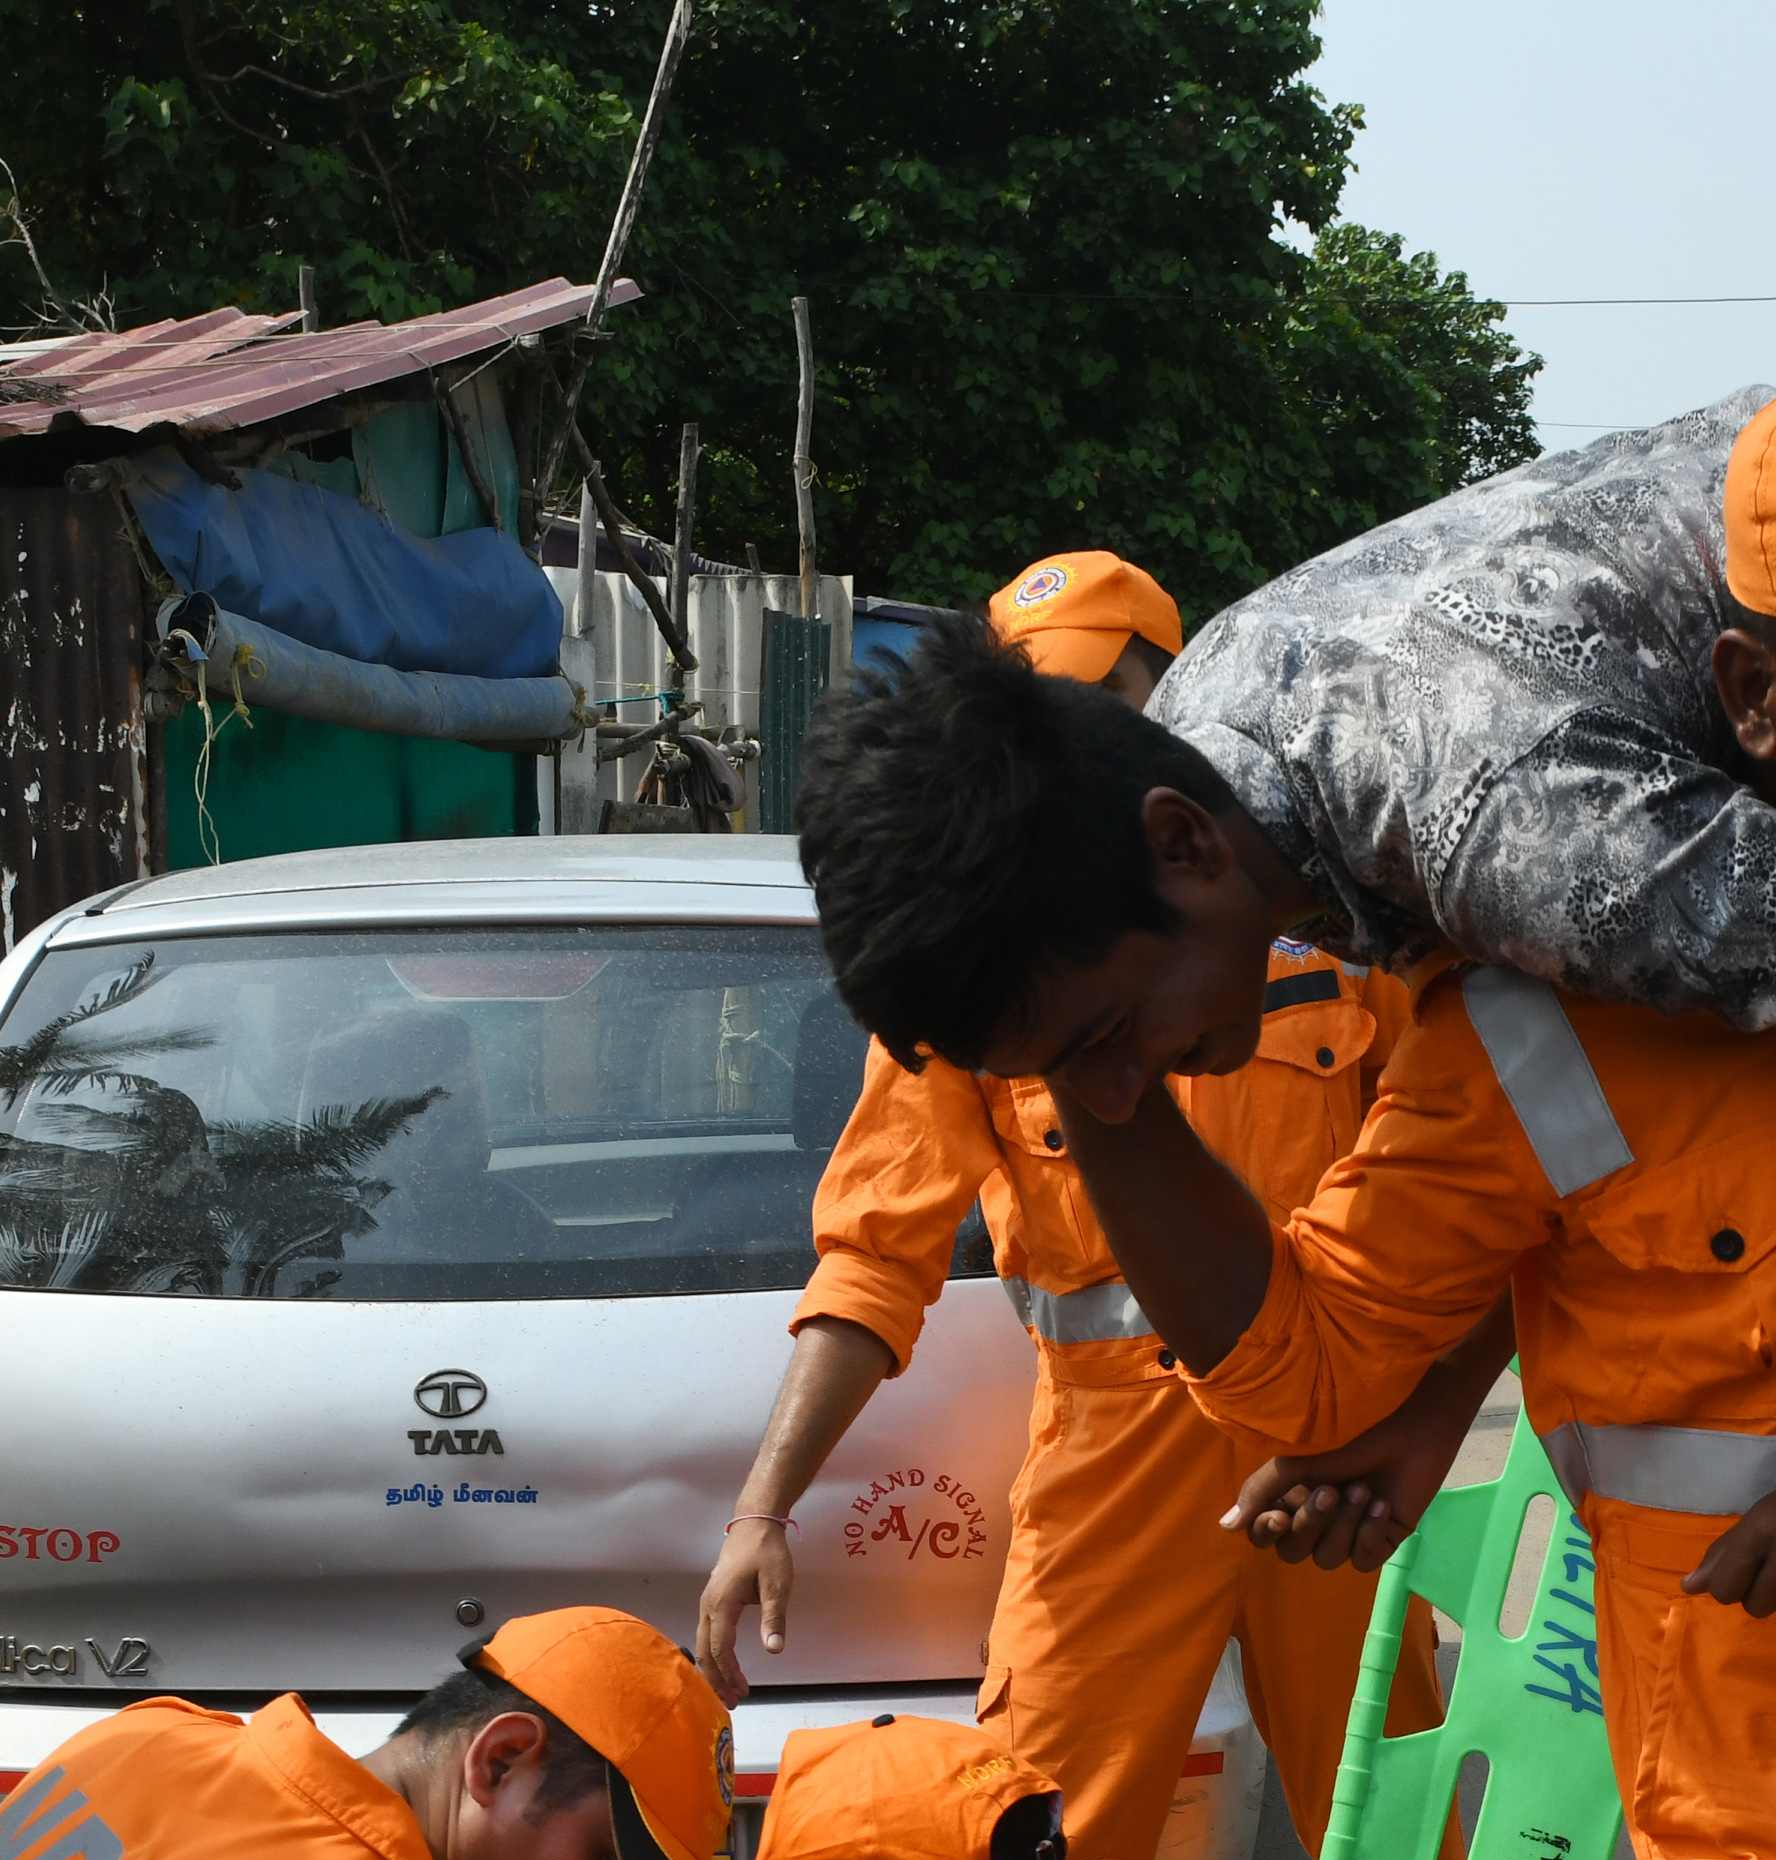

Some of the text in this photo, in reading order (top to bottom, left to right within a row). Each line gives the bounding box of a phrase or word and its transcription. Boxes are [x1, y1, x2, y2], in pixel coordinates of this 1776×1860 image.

[407, 1429, 505, 1456] TATA
[385, 1482, 539, 1508] தமிழ் மீனவன்
[843, 1468, 987, 1560] NO HAND SIGNAL
[871, 1504, 960, 1560] A/C
[84, 1637, 152, 1678] V2
